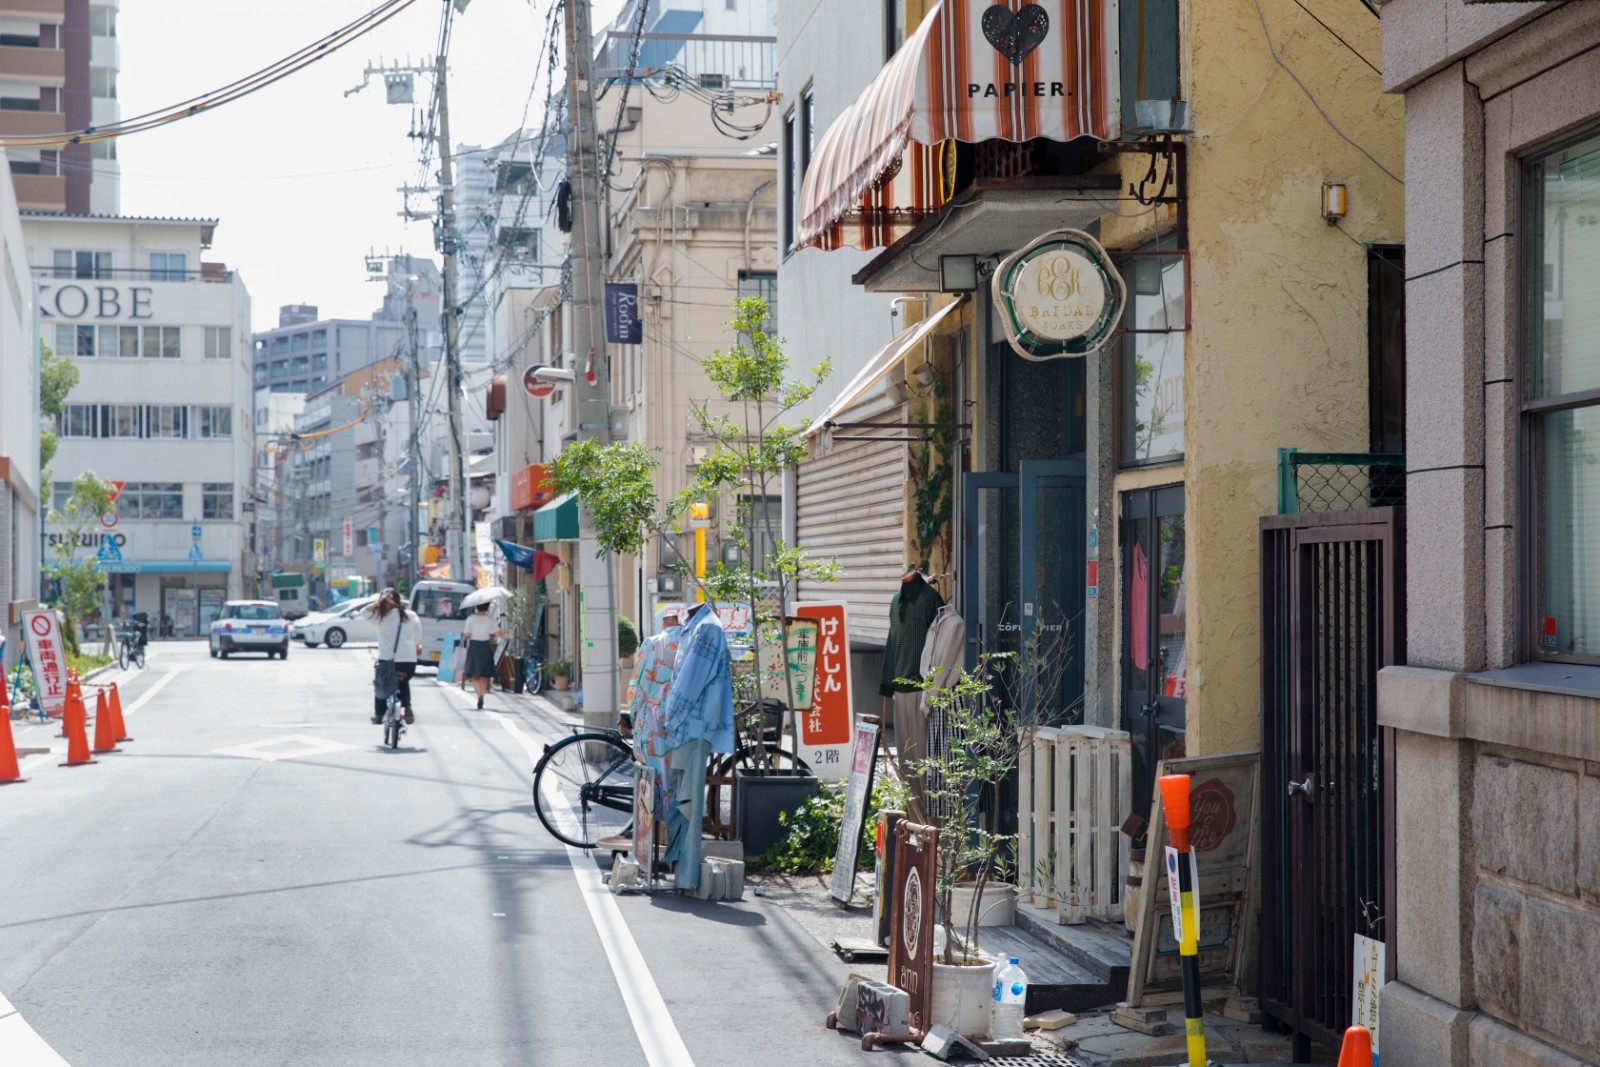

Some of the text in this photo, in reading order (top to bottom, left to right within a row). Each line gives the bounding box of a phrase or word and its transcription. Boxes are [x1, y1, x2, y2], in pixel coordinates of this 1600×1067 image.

[1029, 306, 1093, 319] BRIDAL
[1041, 321, 1084, 330] WORKS
[820, 616, 842, 693] けんしん
[36, 639, 63, 696] 車両通行止
[814, 750, 840, 764] 2階
[900, 965, 918, 994] ann
